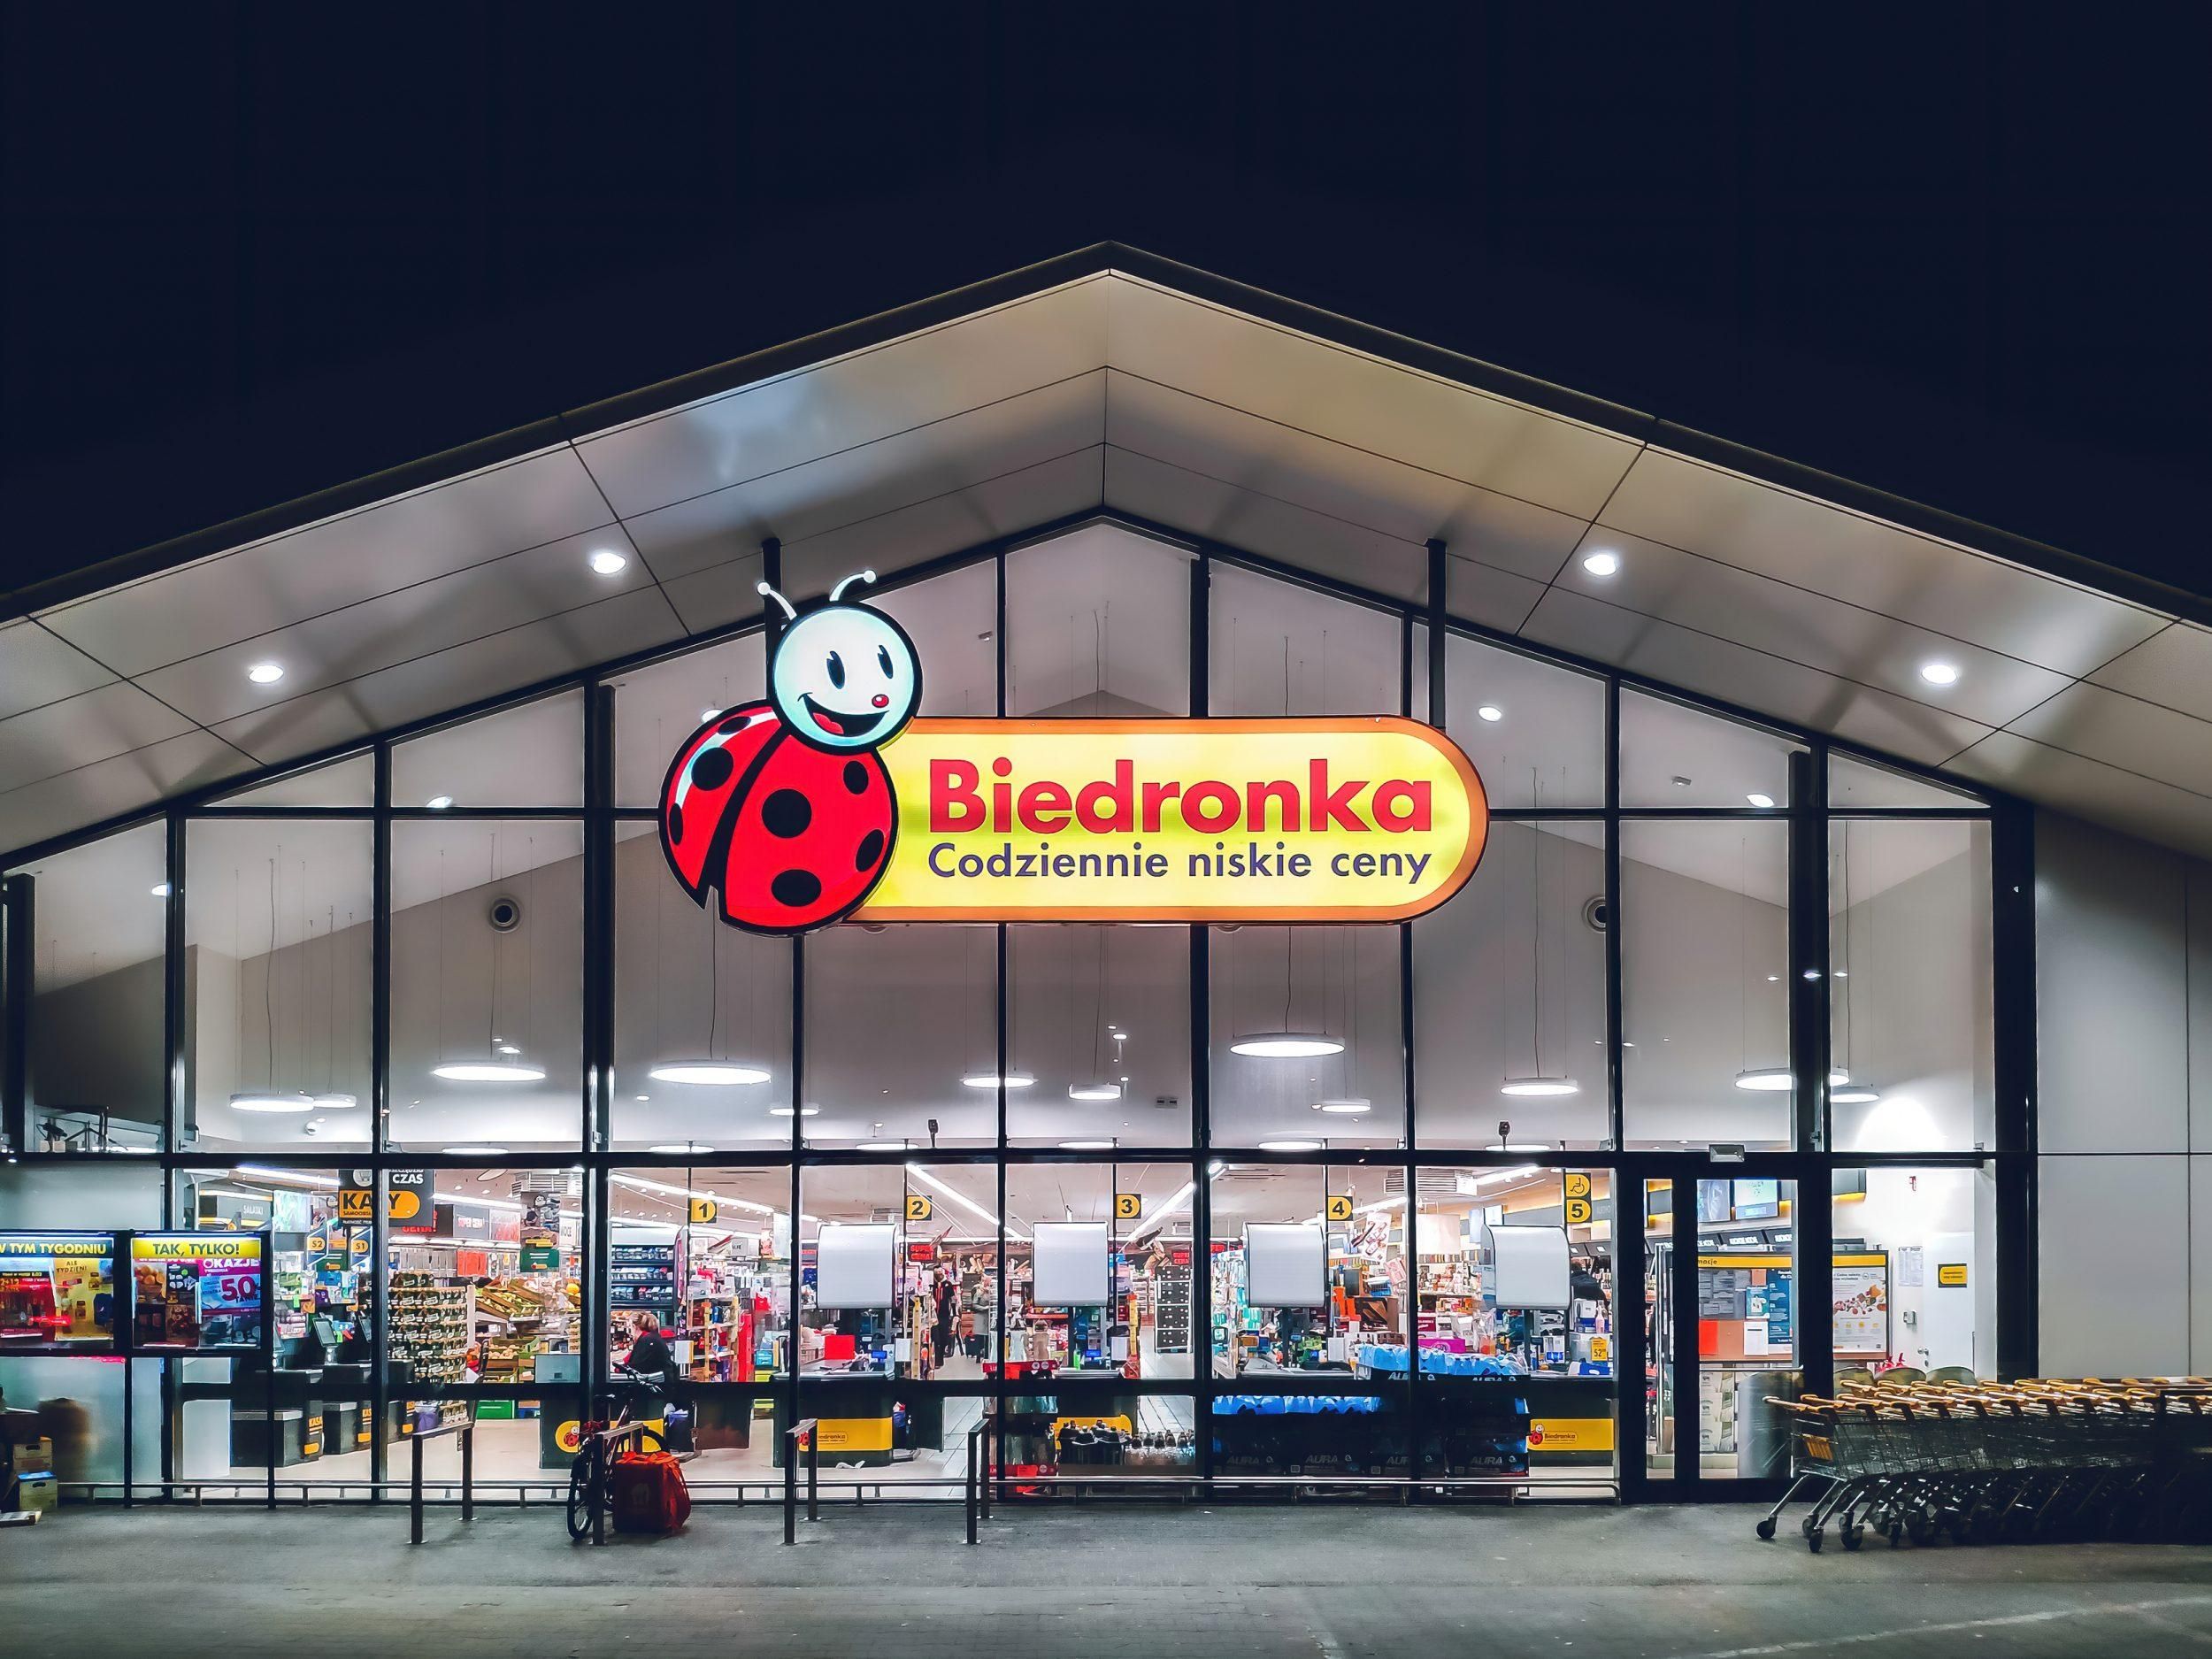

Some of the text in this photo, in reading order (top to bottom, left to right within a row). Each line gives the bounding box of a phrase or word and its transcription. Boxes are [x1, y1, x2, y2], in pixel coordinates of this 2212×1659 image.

[930, 757, 1432, 833] Biedronka
[928, 843, 1432, 886] Codziennie niskie ceny
[392, 1173, 424, 1184] CZAS
[343, 1193, 401, 1210] KAY
[911, 1201, 924, 1215] 2
[1121, 1198, 1133, 1214] 3
[1332, 1201, 1345, 1215] 4
[699, 1203, 708, 1217] 1
[1571, 1203, 1584, 1218] 5
[9, 1243, 36, 1254] TYM
[39, 1243, 106, 1255] TYGODNIU
[152, 1243, 240, 1256] TAK, TYLKO!
